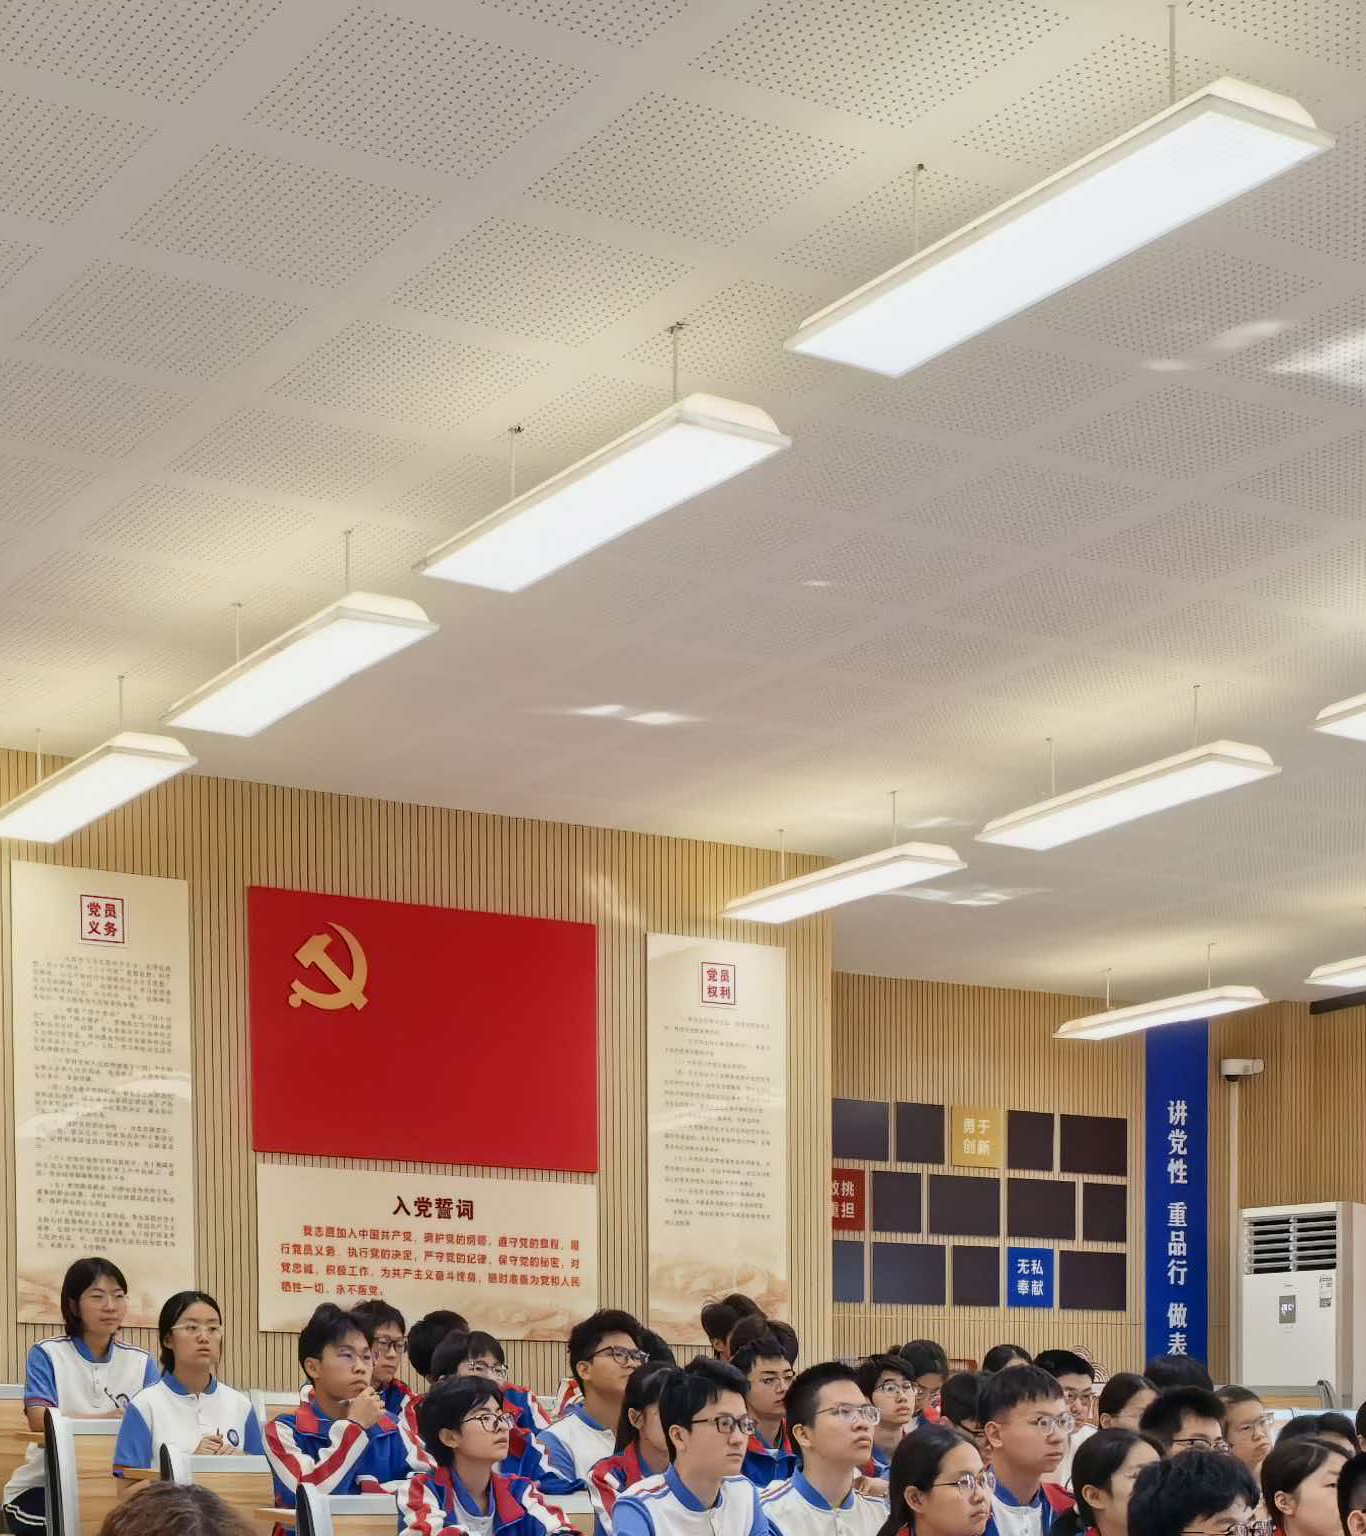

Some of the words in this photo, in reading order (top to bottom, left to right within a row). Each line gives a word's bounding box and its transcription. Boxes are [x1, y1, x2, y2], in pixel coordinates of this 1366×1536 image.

[87, 901, 117, 919] 党员
[88, 921, 117, 937] 义务
[707, 968, 730, 983] 党员
[707, 985, 731, 1000] 权利
[963, 1118, 991, 1134] 勇于
[963, 1138, 991, 1156] 创新
[1167, 1100, 1188, 1184] 讲党性
[393, 1195, 474, 1220] 入党誓词
[1167, 1202, 1188, 1285] 重品行
[1017, 1259, 1044, 1275] 无私
[1017, 1280, 1044, 1296] 奉献
